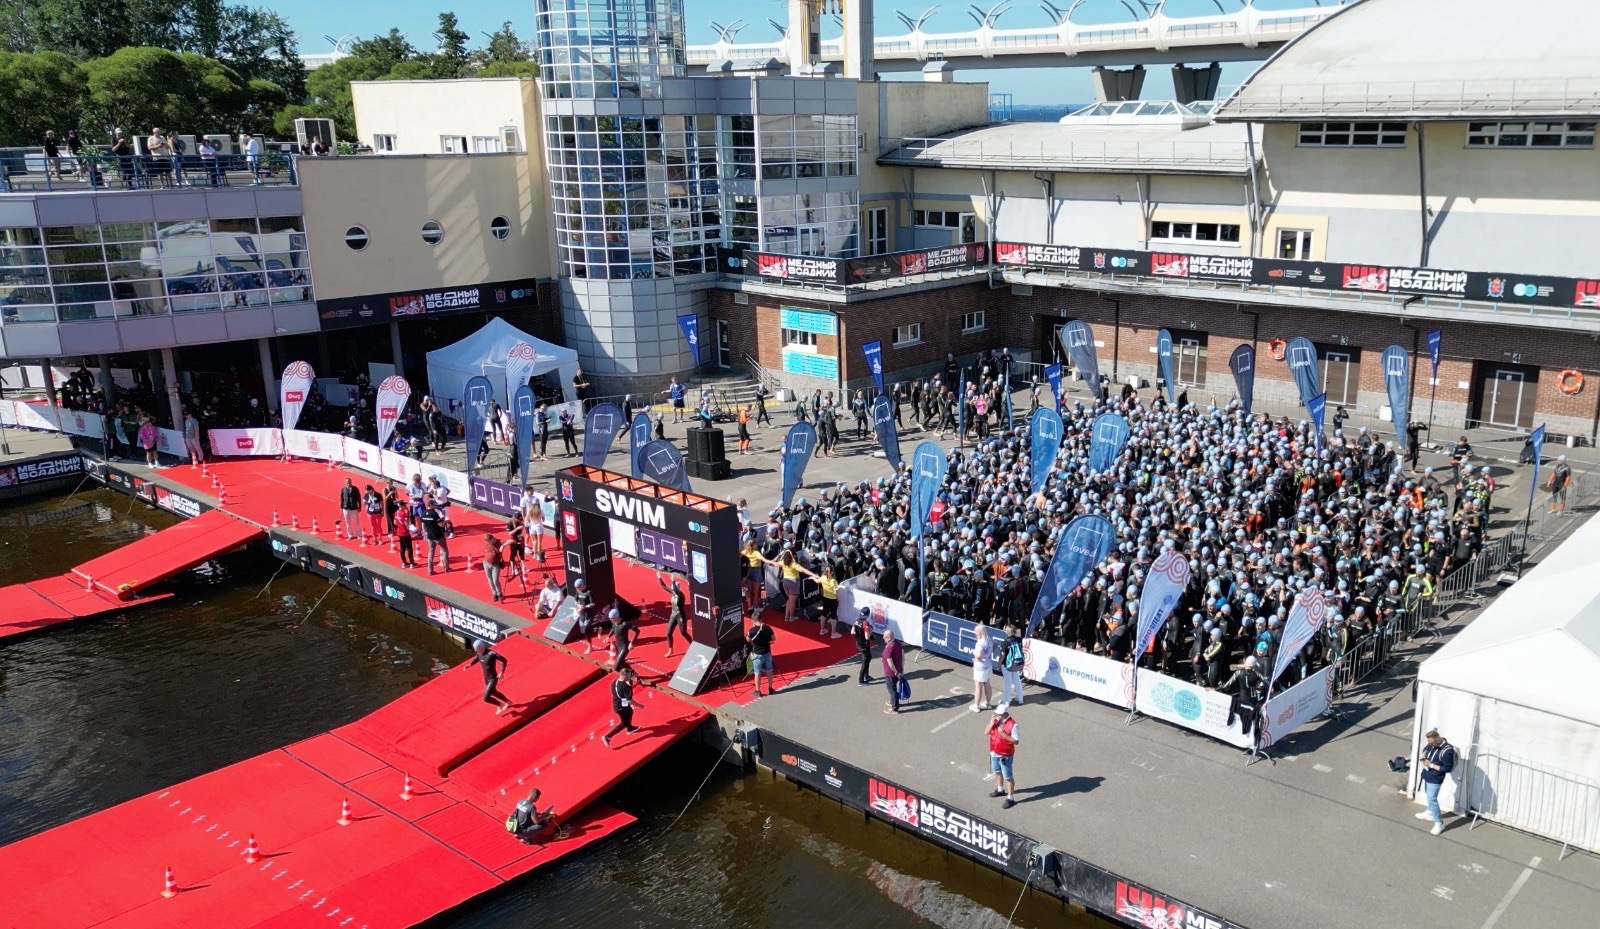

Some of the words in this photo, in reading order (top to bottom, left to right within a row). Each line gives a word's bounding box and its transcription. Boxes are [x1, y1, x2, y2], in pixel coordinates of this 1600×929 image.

[927, 245, 967, 259] МЕДНЫЙ
[1027, 246, 1080, 257] МЕДНЫЙ
[788, 259, 837, 270] МЕДНЫЙ
[927, 254, 967, 267] ВСАДНИК
[1028, 253, 1080, 265] ВСАДНИК
[1189, 256, 1253, 268] МЕДНЫЙ
[788, 267, 837, 278] ВСАДНИК
[1190, 265, 1252, 277] ВСАДНИК
[1389, 268, 1468, 283] МЕДНЫЙ
[1389, 279, 1466, 293] ВСАДНИК
[425, 288, 479, 301] МЕДНЫЙ
[426, 296, 480, 309] ВСАДНИК
[17, 456, 80, 473] МЕДНЫЙ
[18, 464, 81, 480] ВСАДНИК
[595, 488, 666, 529] SWIM
[452, 606, 498, 632] МЕДНЫЙ
[1063, 666, 1107, 685] ГАЗПРОМБАНК
[920, 799, 1009, 847] МЕДНЫЙ
[920, 811, 1009, 859] ВСАДНИК
